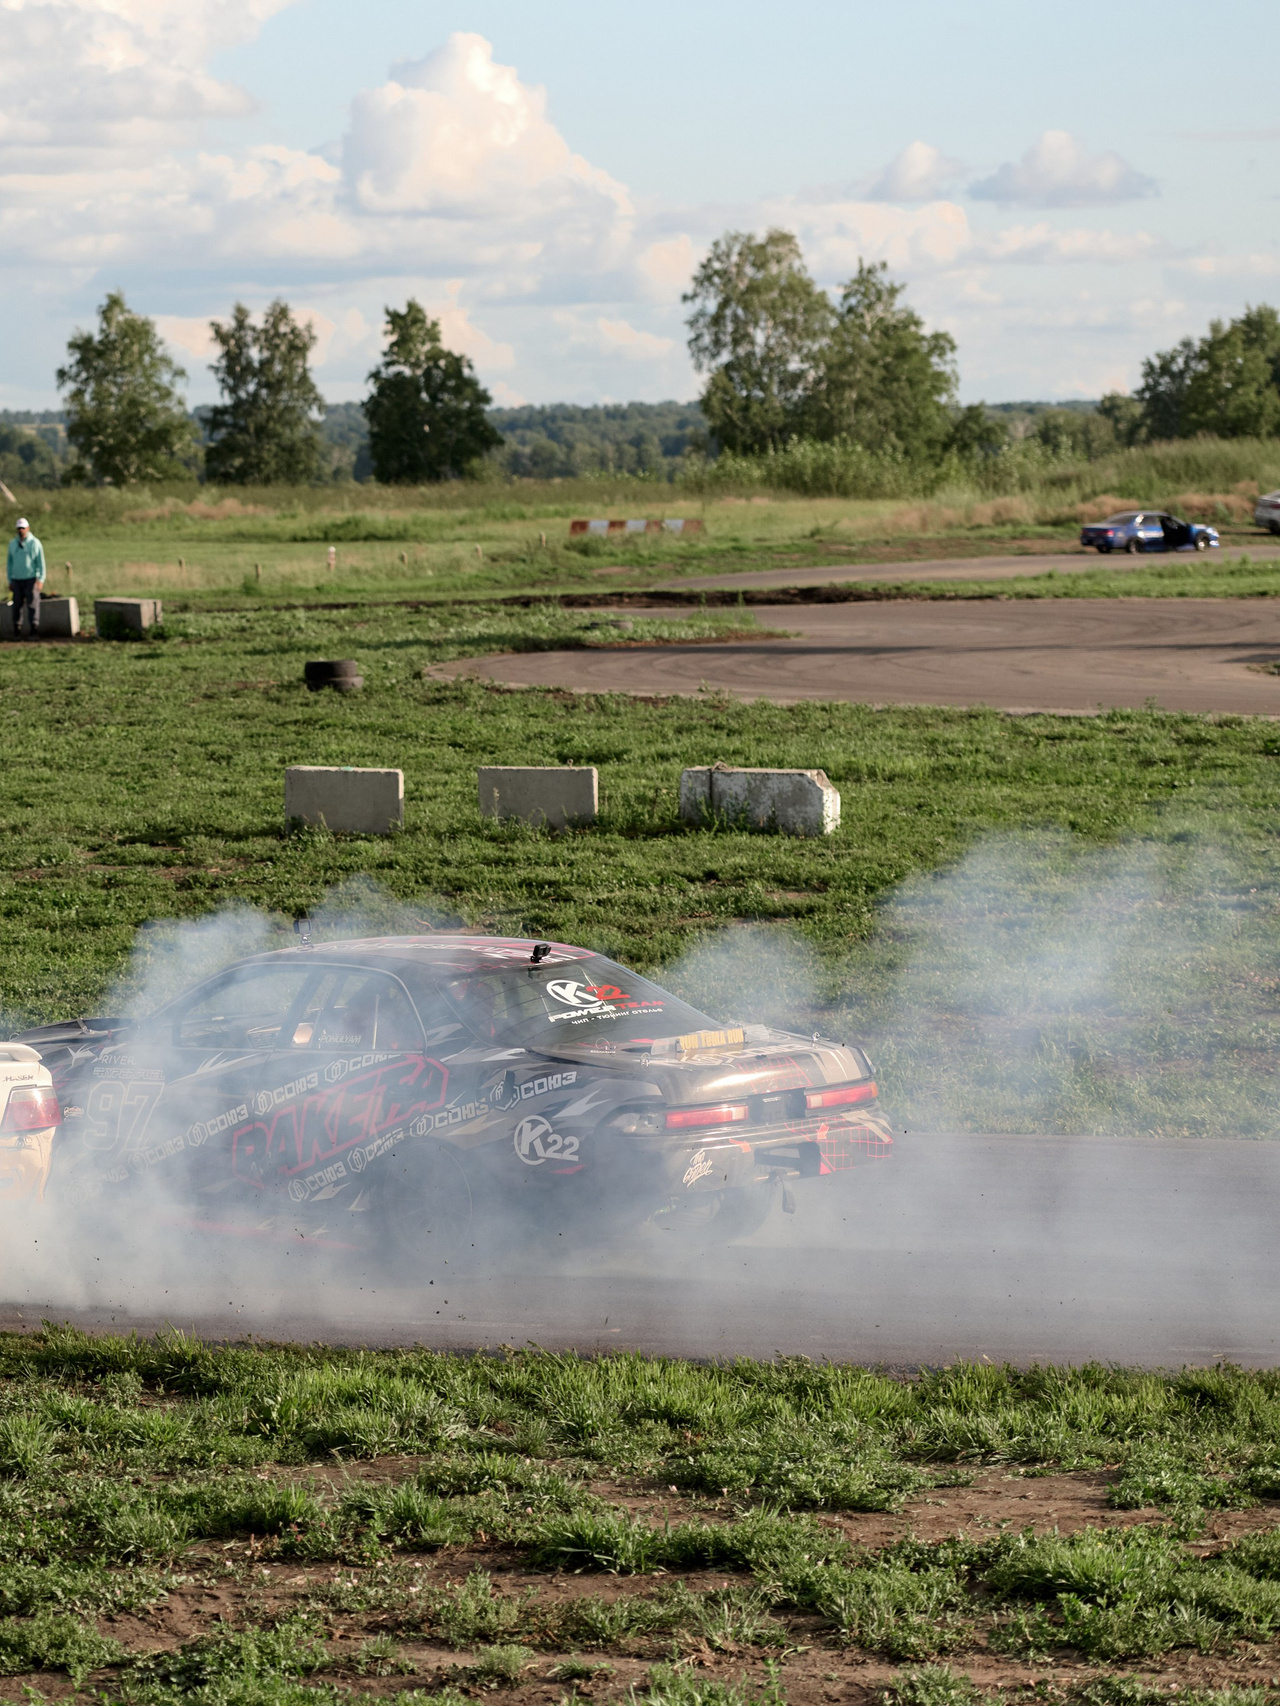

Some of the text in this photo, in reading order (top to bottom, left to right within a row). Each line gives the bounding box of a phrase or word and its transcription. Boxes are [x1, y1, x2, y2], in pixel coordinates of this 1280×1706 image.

[83, 1080, 166, 1151] 97
[206, 1103, 249, 1136] СОЮЗ
[273, 1071, 319, 1104] СОЮЗ
[349, 1054, 401, 1072] СОЮ
[306, 1161, 347, 1191] СОЮЗ
[435, 1099, 489, 1129] СОЮЗ
[520, 1071, 578, 1100] СОЮЗ
[513, 1114, 580, 1166] K22
